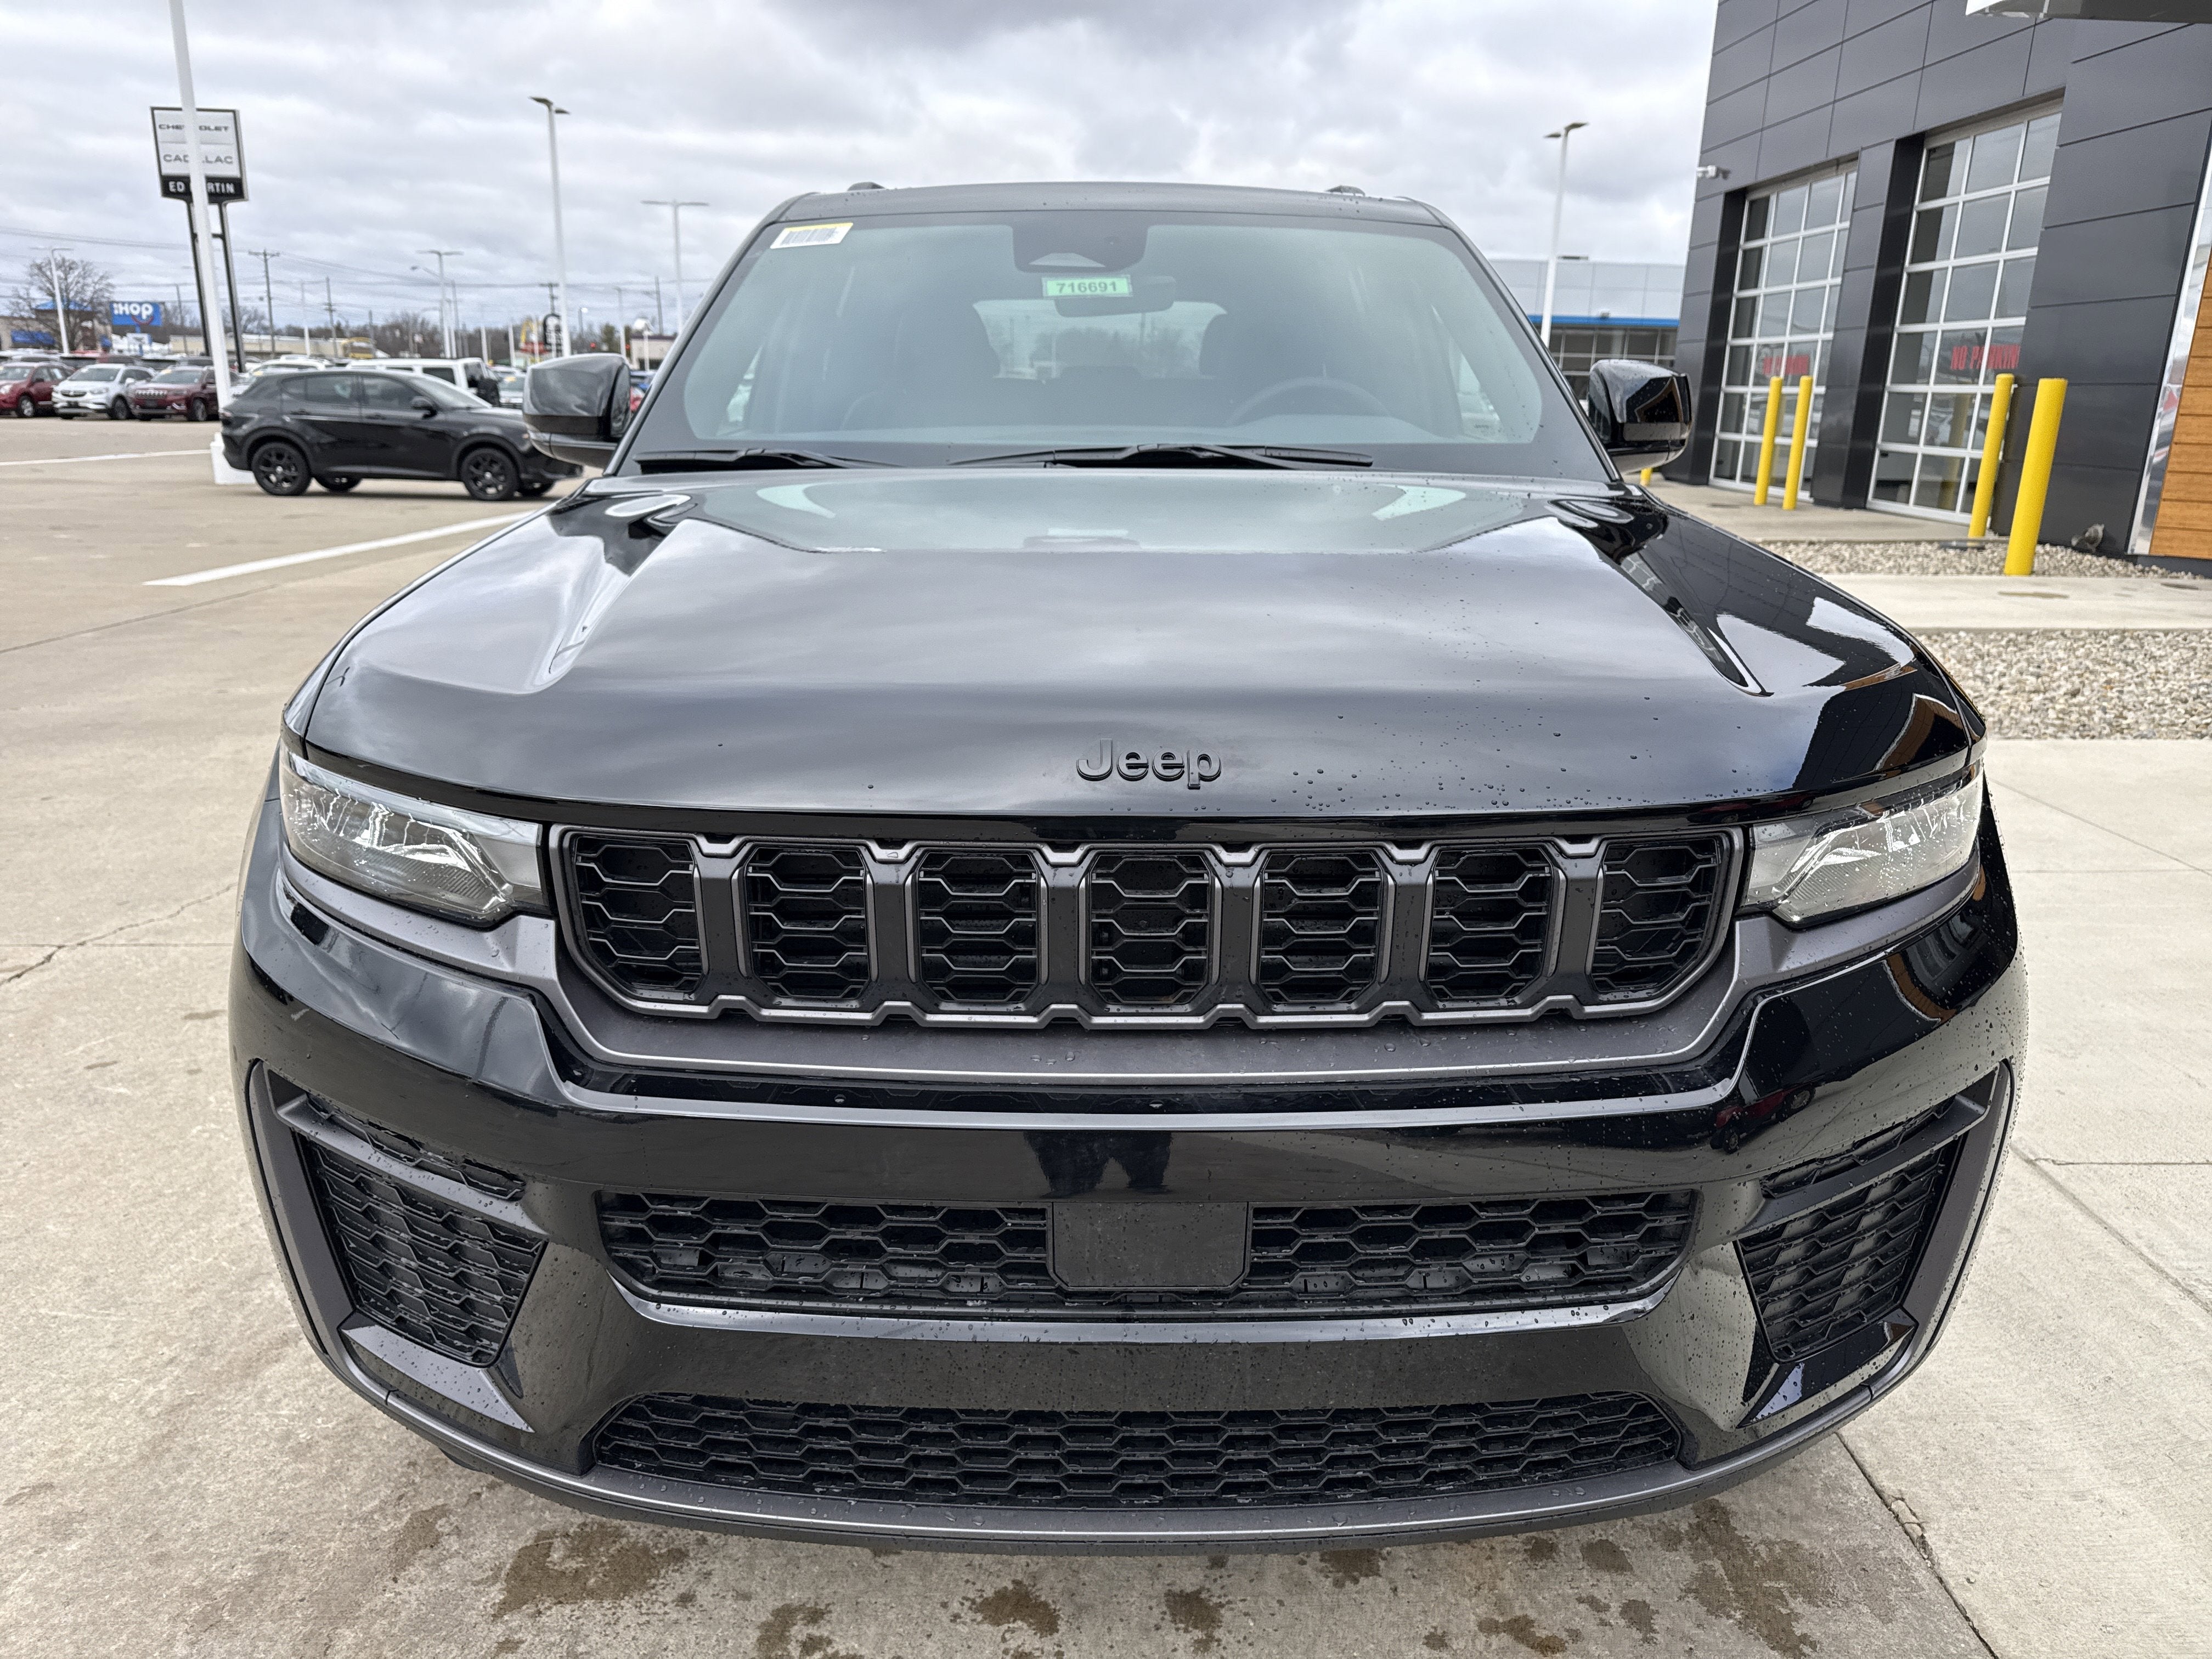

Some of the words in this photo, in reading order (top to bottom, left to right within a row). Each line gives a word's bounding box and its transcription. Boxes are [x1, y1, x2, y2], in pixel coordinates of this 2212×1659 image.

[163, 154, 233, 163] CADLAC
[168, 181, 185, 192] ED
[207, 182, 235, 194] RTIN
[1056, 281, 1117, 294] 716691
[1950, 345, 1968, 370] NO
[1970, 343, 2021, 369] PARKIN
[1076, 738, 1221, 789] Jeep
